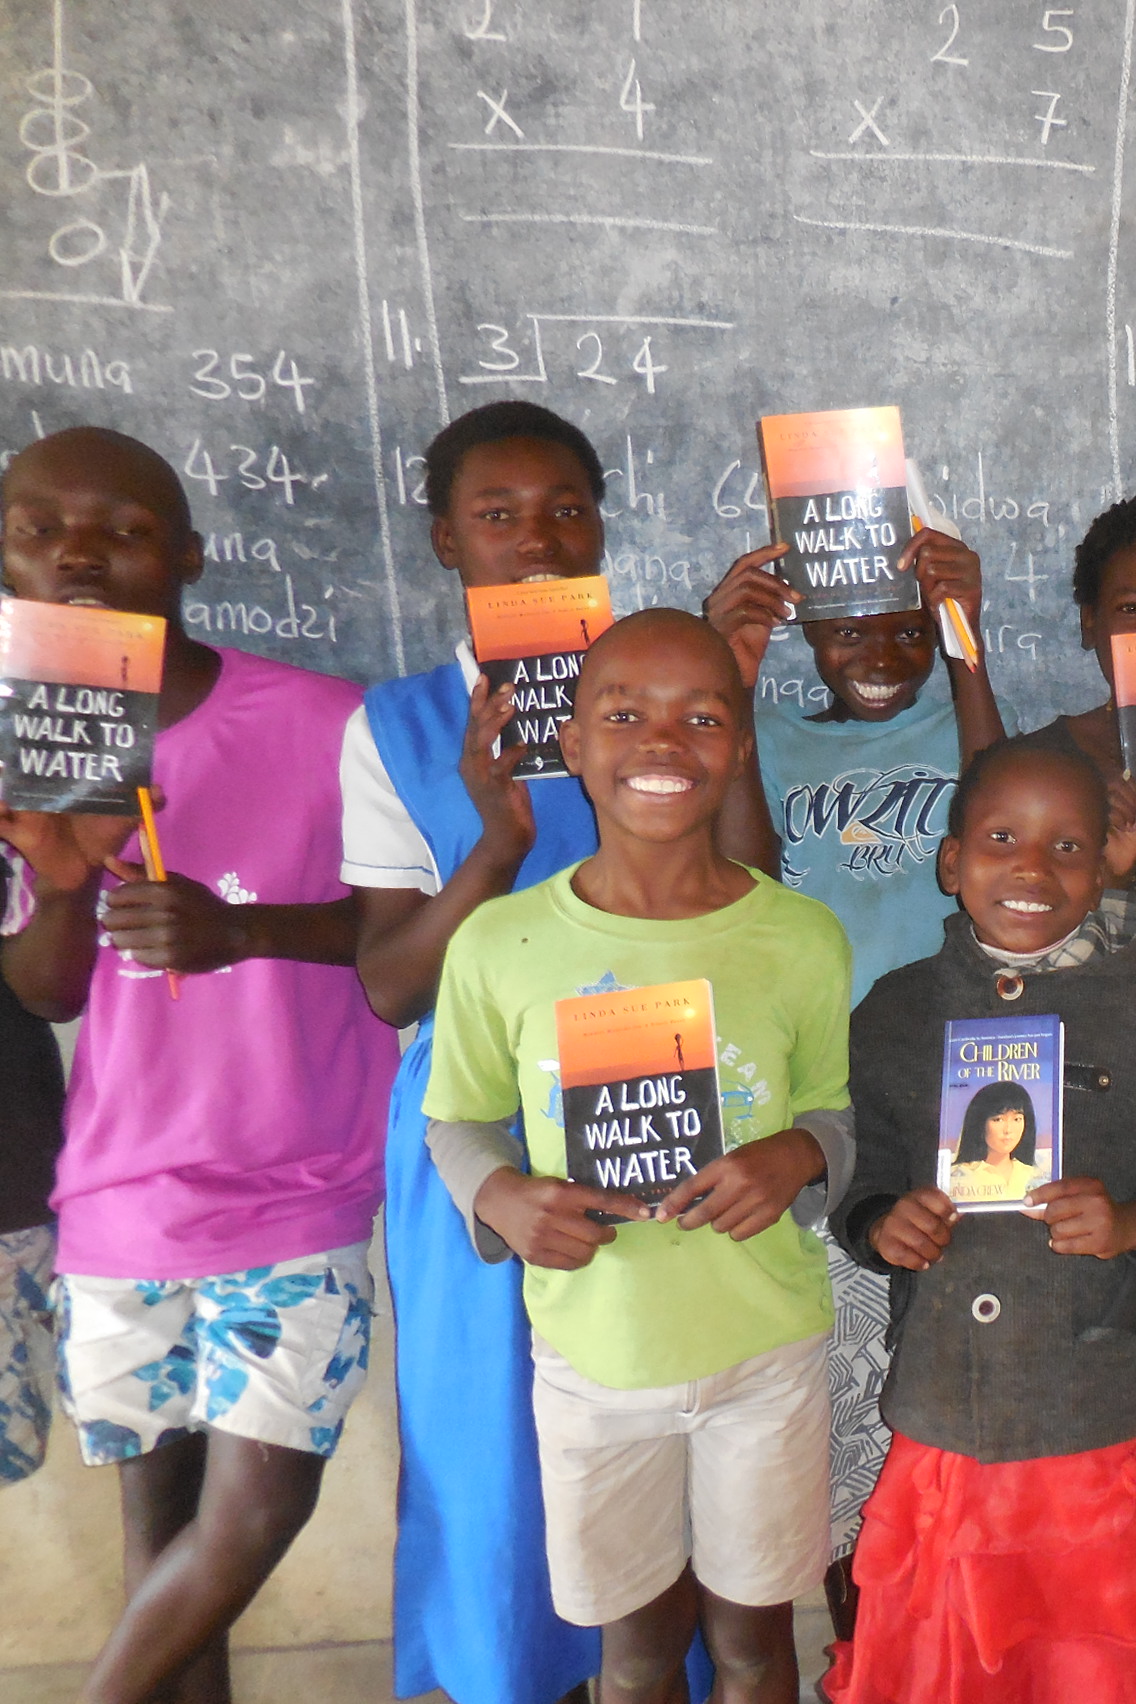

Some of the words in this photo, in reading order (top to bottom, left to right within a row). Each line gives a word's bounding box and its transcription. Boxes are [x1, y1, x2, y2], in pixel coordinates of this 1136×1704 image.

[930, 4, 969, 66] 2
[1032, 10, 1074, 52] 5
[619, 58, 657, 141] 4
[1031, 90, 1068, 144] 7
[477, 323, 520, 371] 3
[189, 349, 314, 413] 354
[803, 498, 821, 525] A
[825, 494, 883, 522] LONG
[795, 525, 862, 554] WALK
[864, 522, 897, 548] TO
[805, 555, 895, 588] WATER
[514, 660, 530, 685] A
[28, 684, 48, 710] A
[55, 687, 126, 718] LONG
[13, 713, 94, 745] WALK
[99, 722, 136, 749] TO
[19, 746, 125, 783] WATER
[573, 1009, 616, 1021] LINDA
[655, 997, 691, 1009] PARK
[960, 1041, 1038, 1063] CHILDREN
[957, 1067, 972, 1079] OF
[974, 1066, 995, 1078] THE
[997, 1060, 1041, 1082] RIVER
[594, 1084, 614, 1117] A
[620, 1075, 687, 1112] LONG
[584, 1114, 662, 1151] WALK
[665, 1107, 702, 1140] TO
[595, 1146, 698, 1189] WATER
